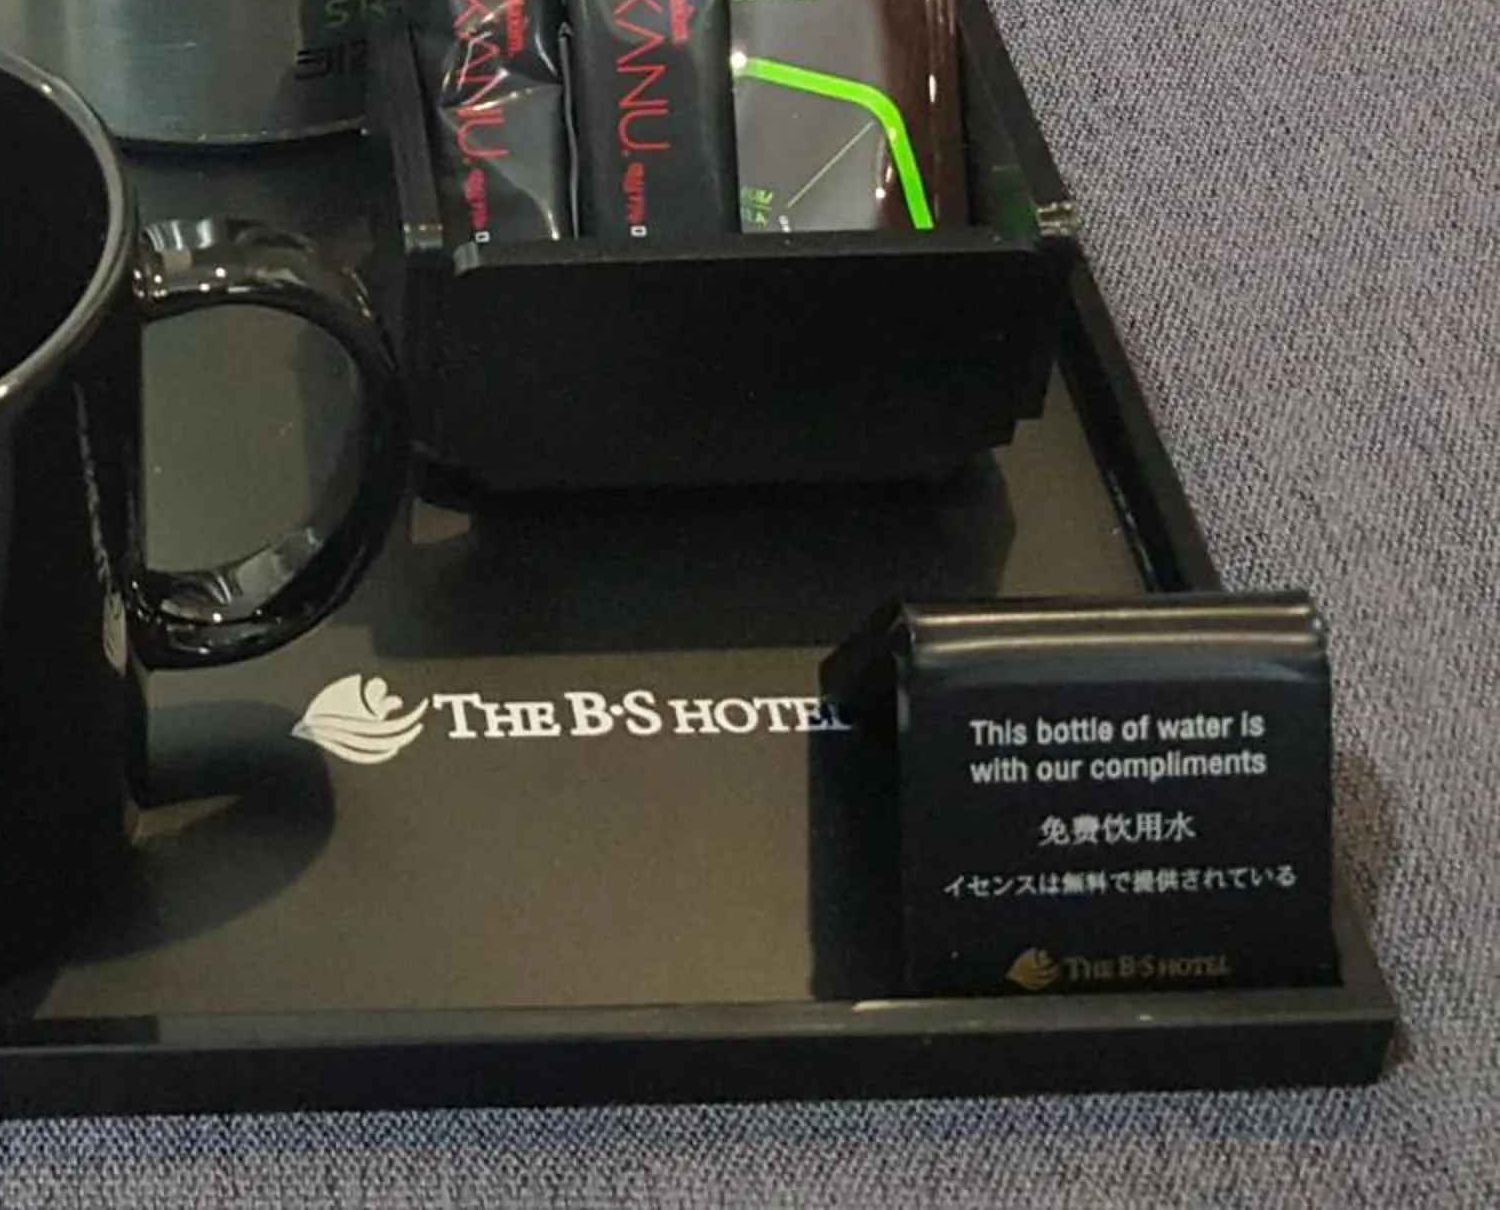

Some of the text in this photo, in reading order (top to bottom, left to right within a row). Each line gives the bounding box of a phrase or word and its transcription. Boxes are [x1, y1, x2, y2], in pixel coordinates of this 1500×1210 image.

[433, 691, 561, 739] THE
[667, 696, 853, 735] HOTEL
[969, 711, 1265, 746] This bottle of water is
[970, 749, 1268, 783] with our compliments
